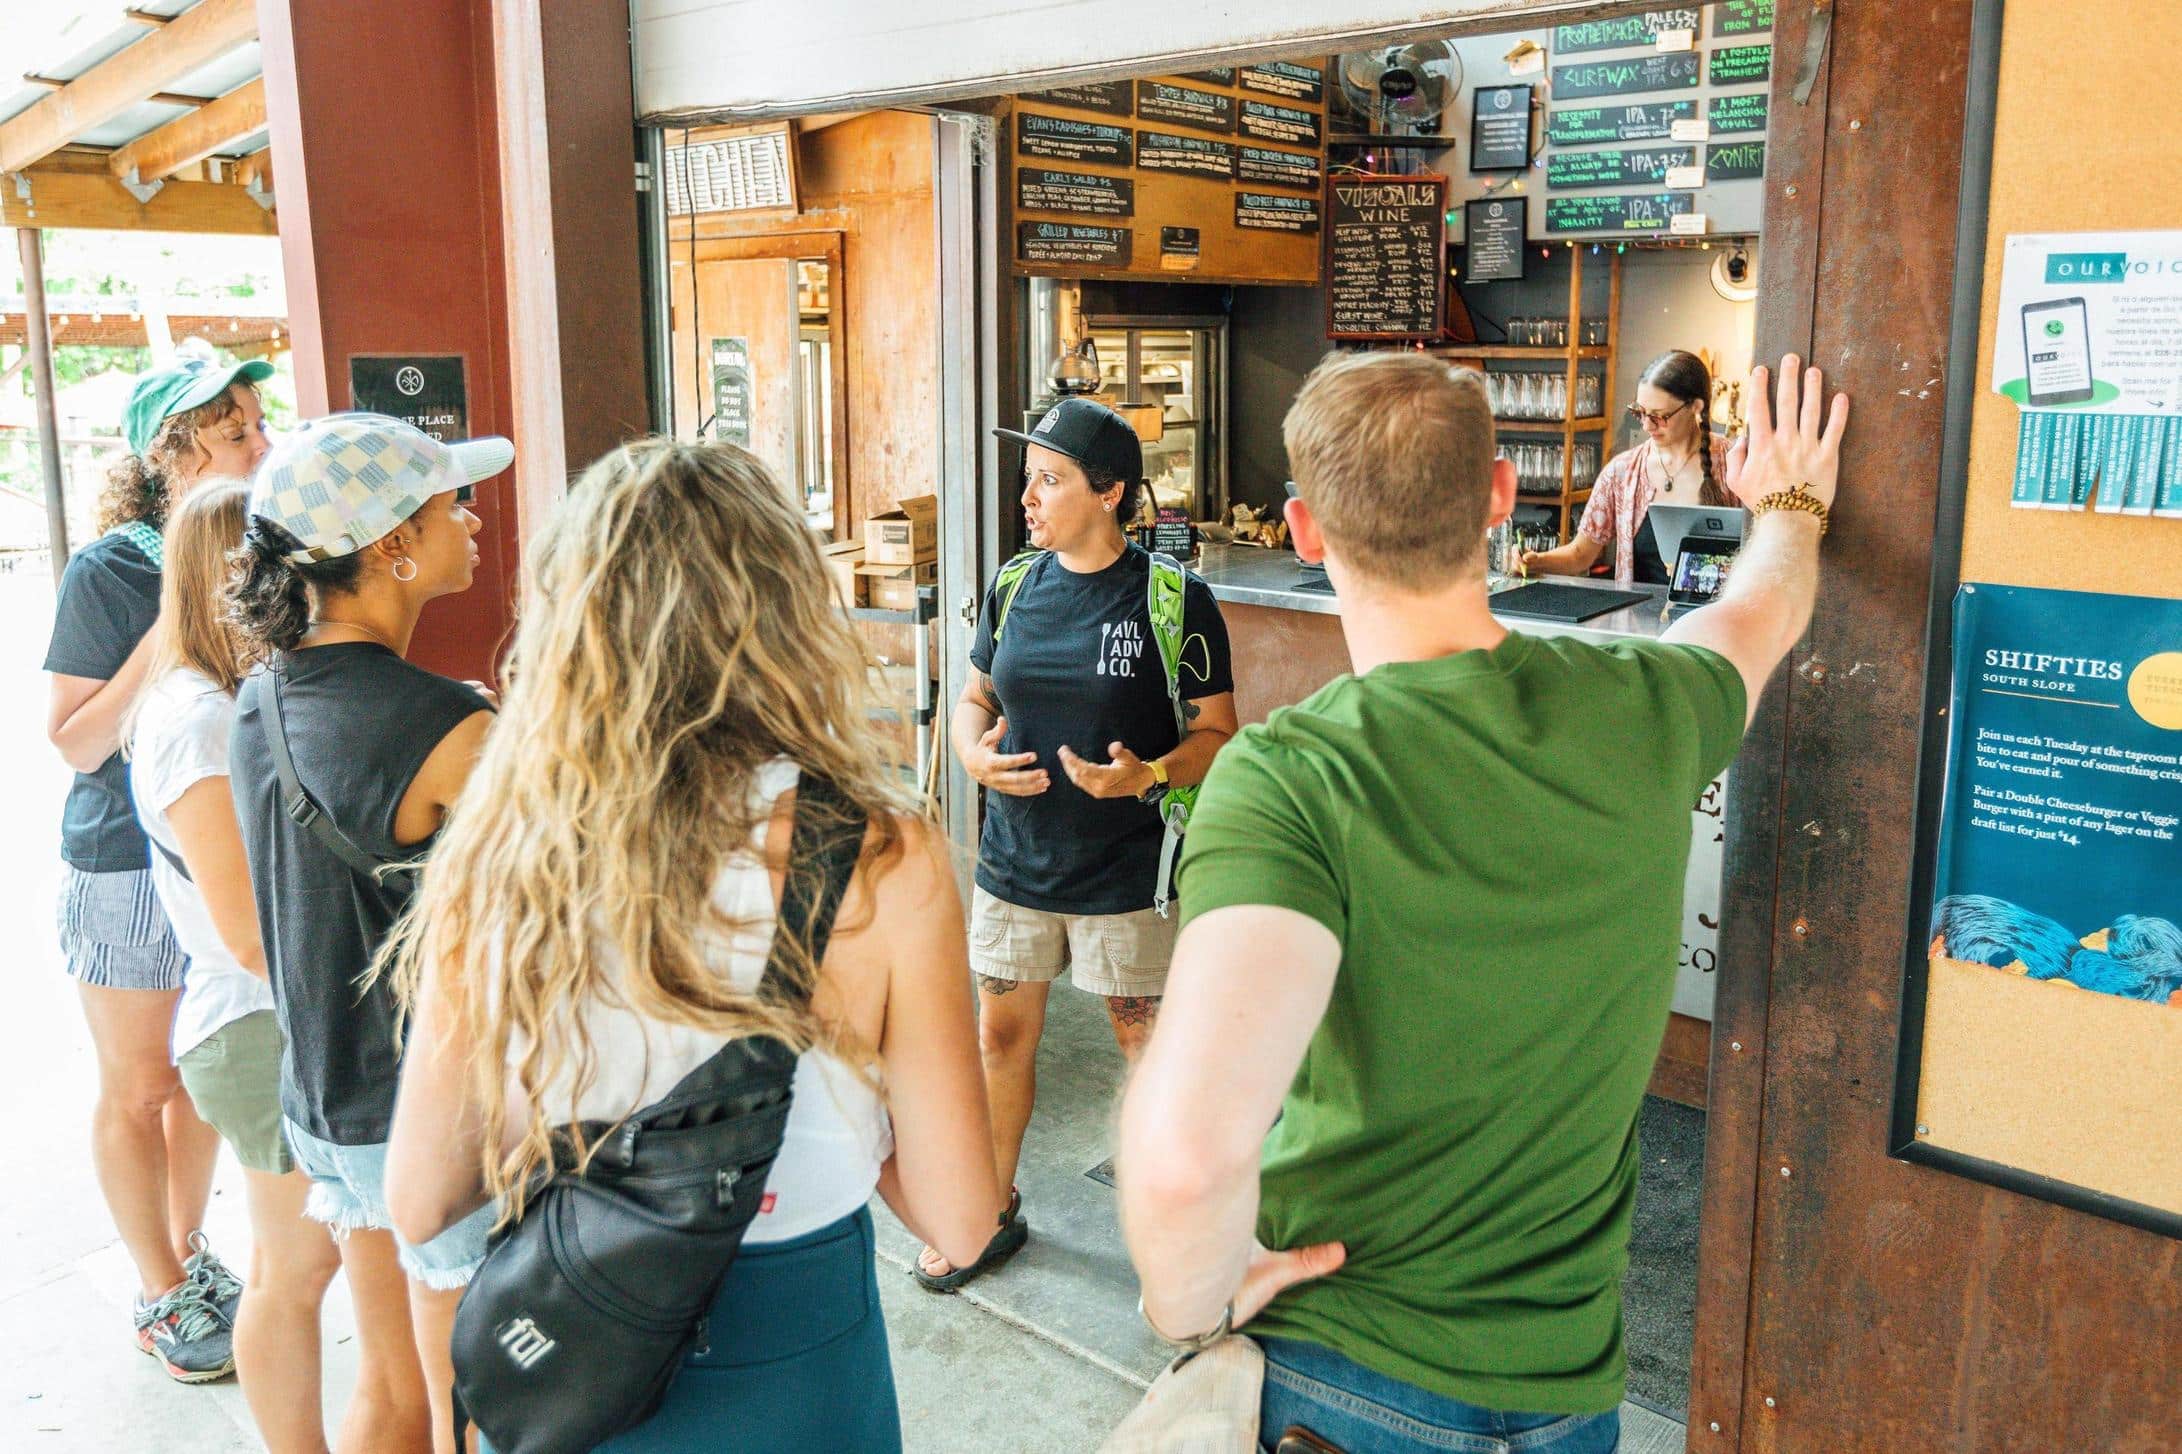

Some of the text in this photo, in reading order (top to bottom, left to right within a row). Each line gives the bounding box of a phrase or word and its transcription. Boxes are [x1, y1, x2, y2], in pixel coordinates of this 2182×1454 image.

[1564, 63, 1640, 89] SURFWAX
[1720, 98, 1726, 109] A
[1626, 107, 1647, 124] IPA
[1631, 154, 1655, 173] IPA
[1335, 184, 1436, 208] VISUALS
[1359, 208, 1412, 222] WINE
[1629, 199, 1653, 220] IPA
[2058, 261, 2112, 276] OUR
[417, 414, 455, 426] PLACE
[1111, 620, 1141, 640] AVL
[1110, 640, 1143, 658] ADV
[1109, 658, 1136, 678] CO.
[1985, 649, 2123, 680] SHIFTIES
[1982, 673, 2076, 693] SOUTH SLOPE
[1976, 727, 2177, 764] Join us each Tuesday at the taproom
[1976, 756, 2064, 779] You've earned it.
[1977, 742, 1997, 754] bite
[1999, 748, 2011, 756] to
[2012, 751, 2029, 760] eat
[2031, 752, 2052, 762] and
[2052, 756, 2080, 767] pour
[2081, 758, 2097, 768] of
[2095, 764, 2159, 780] something
[1973, 785, 2179, 827] Pair a Double Cheeseburger or Veggie
[1971, 816, 1997, 829] draft
[1998, 821, 2016, 833] list
[2017, 824, 2034, 836] for
[2033, 828, 2057, 840] just
[1973, 799, 2174, 839] Burger with a pint of any lager on the
